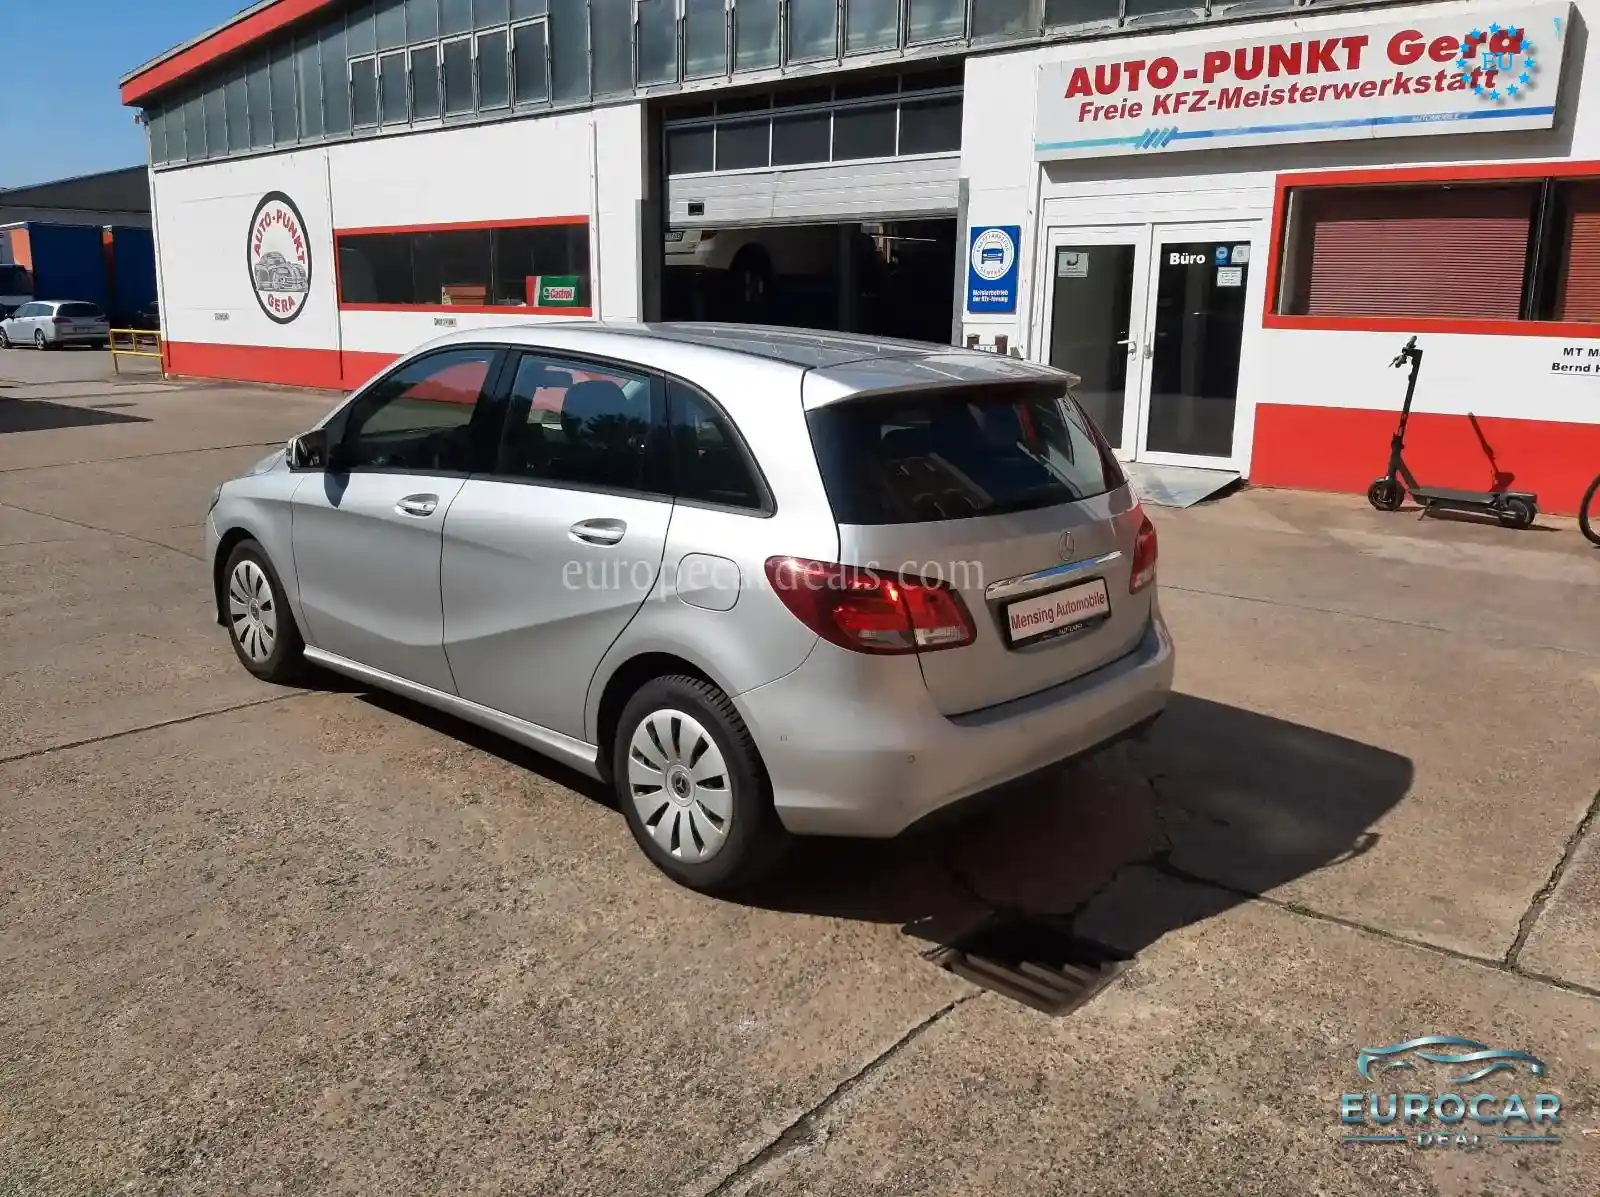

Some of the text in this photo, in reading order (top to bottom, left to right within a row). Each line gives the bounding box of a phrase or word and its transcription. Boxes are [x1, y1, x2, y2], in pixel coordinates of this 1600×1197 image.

[1064, 28, 1525, 98] AUTO-PUNKT Gera
[1078, 66, 1499, 122] Freie KFZ-Meisterwerkstatt
[1169, 252, 1206, 265] Büro
[267, 293, 296, 312] GERA
[1563, 347, 1600, 357] MT M
[1552, 362, 1591, 373] Bernd
[1011, 606, 1055, 630] Mensing
[1056, 592, 1105, 618] Automobile
